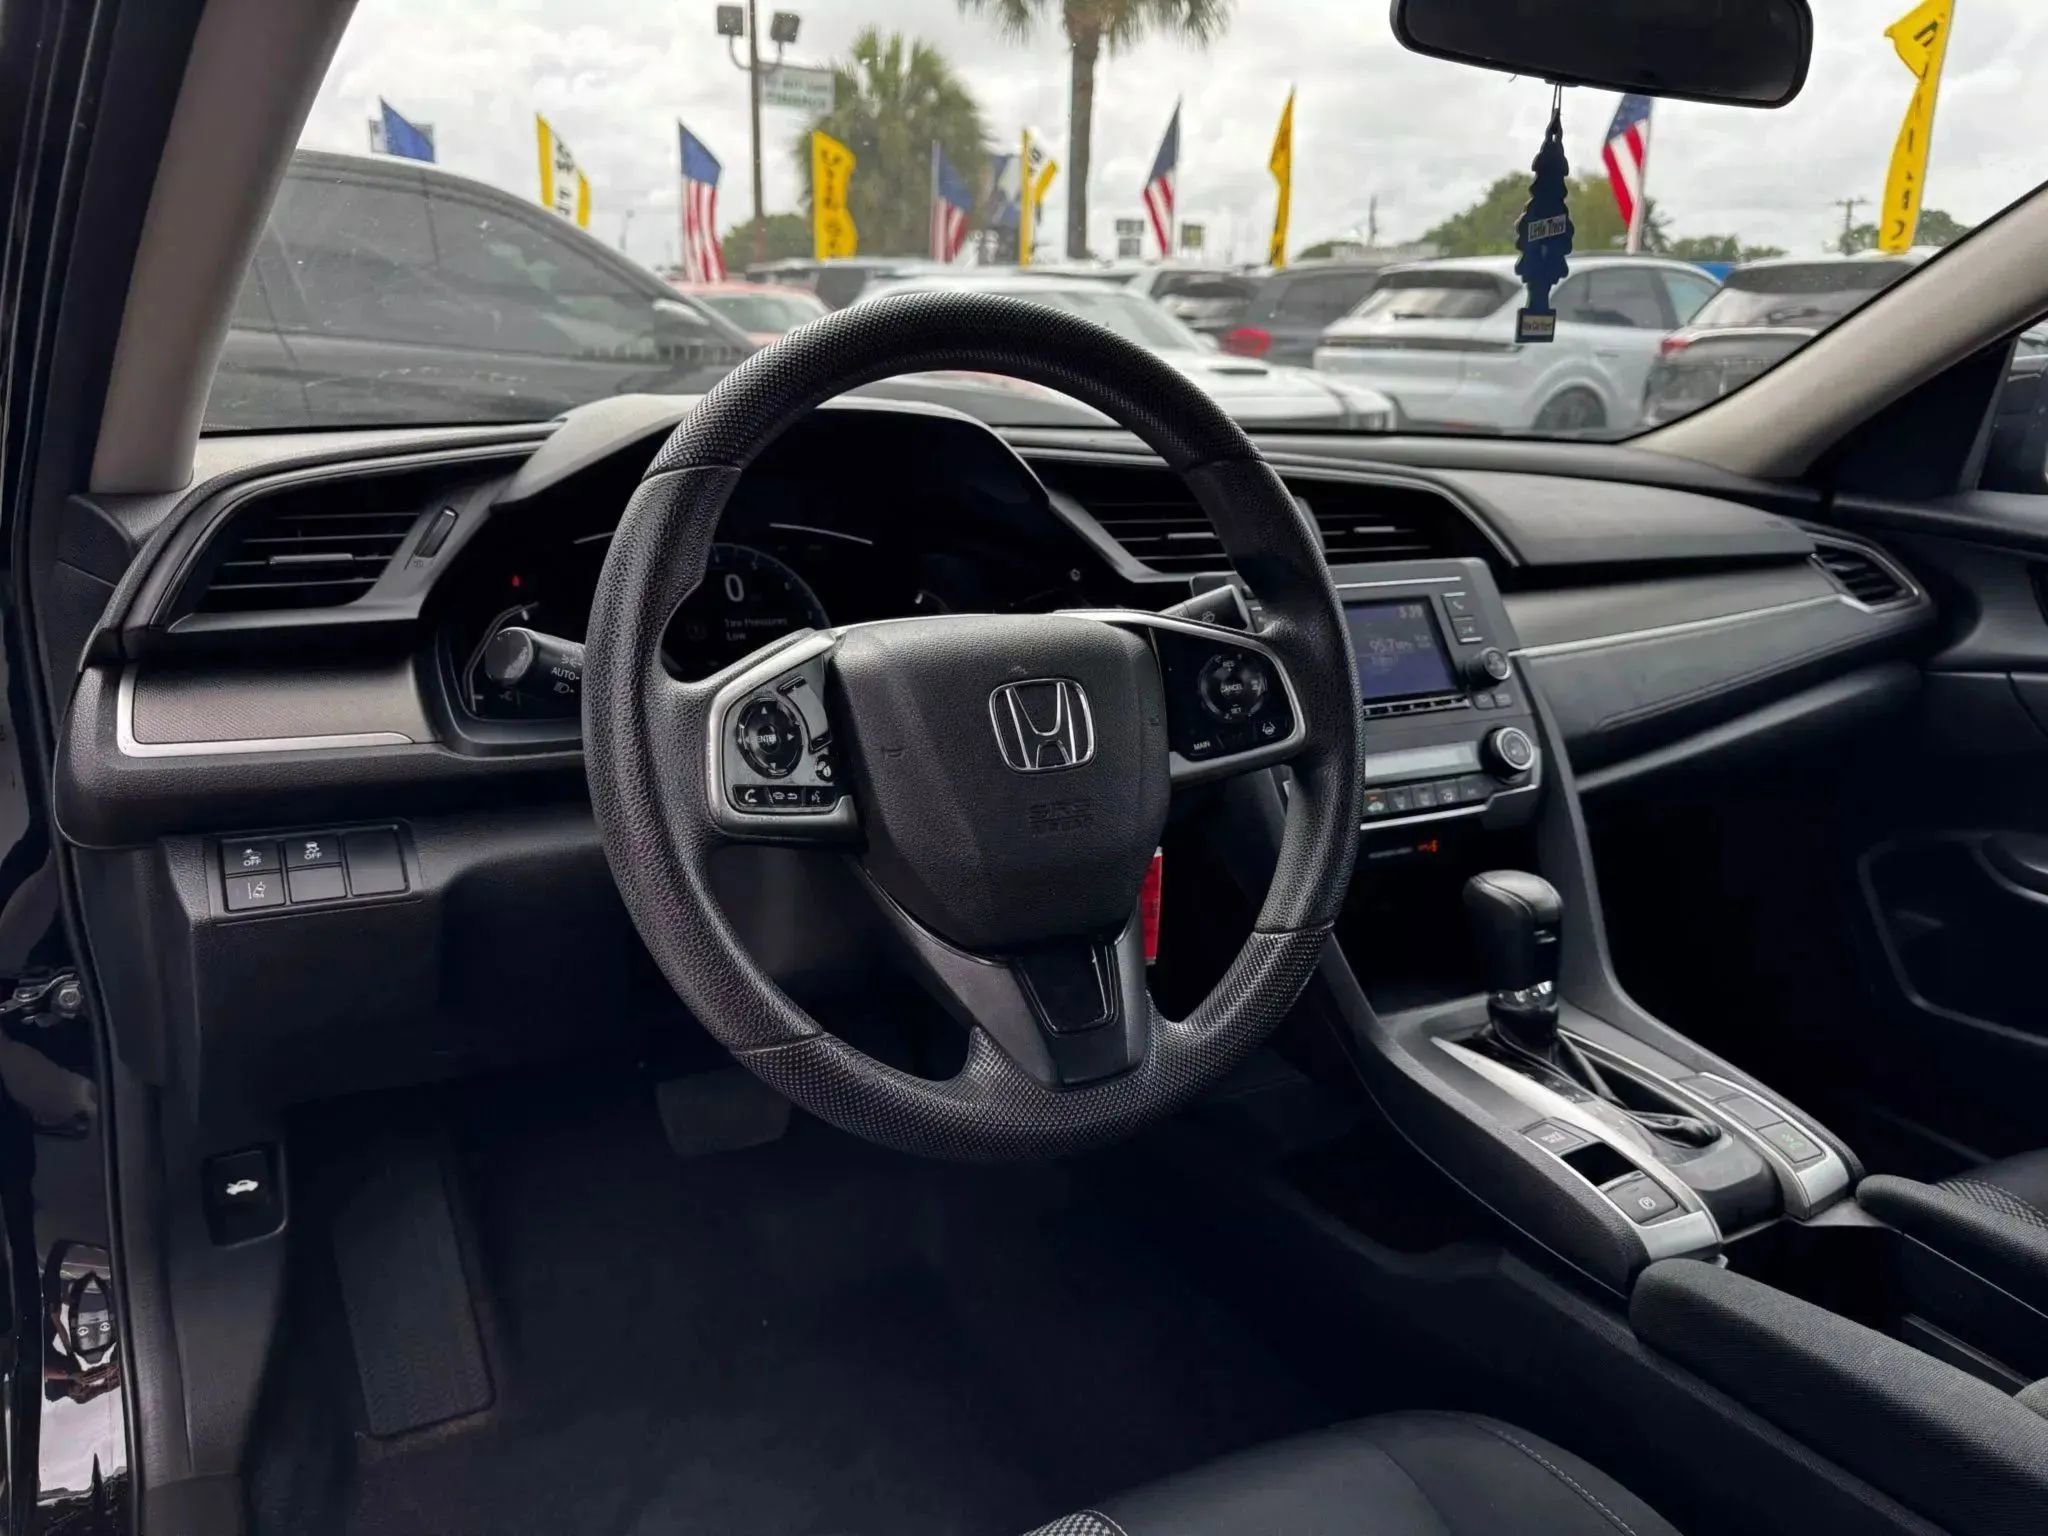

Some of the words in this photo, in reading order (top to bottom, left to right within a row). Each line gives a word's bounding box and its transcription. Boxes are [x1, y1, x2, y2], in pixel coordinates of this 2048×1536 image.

[724, 573, 745, 603] 0
[551, 666, 576, 682] AUTO
[304, 852, 323, 861] OFF
[243, 859, 262, 867] OFF
